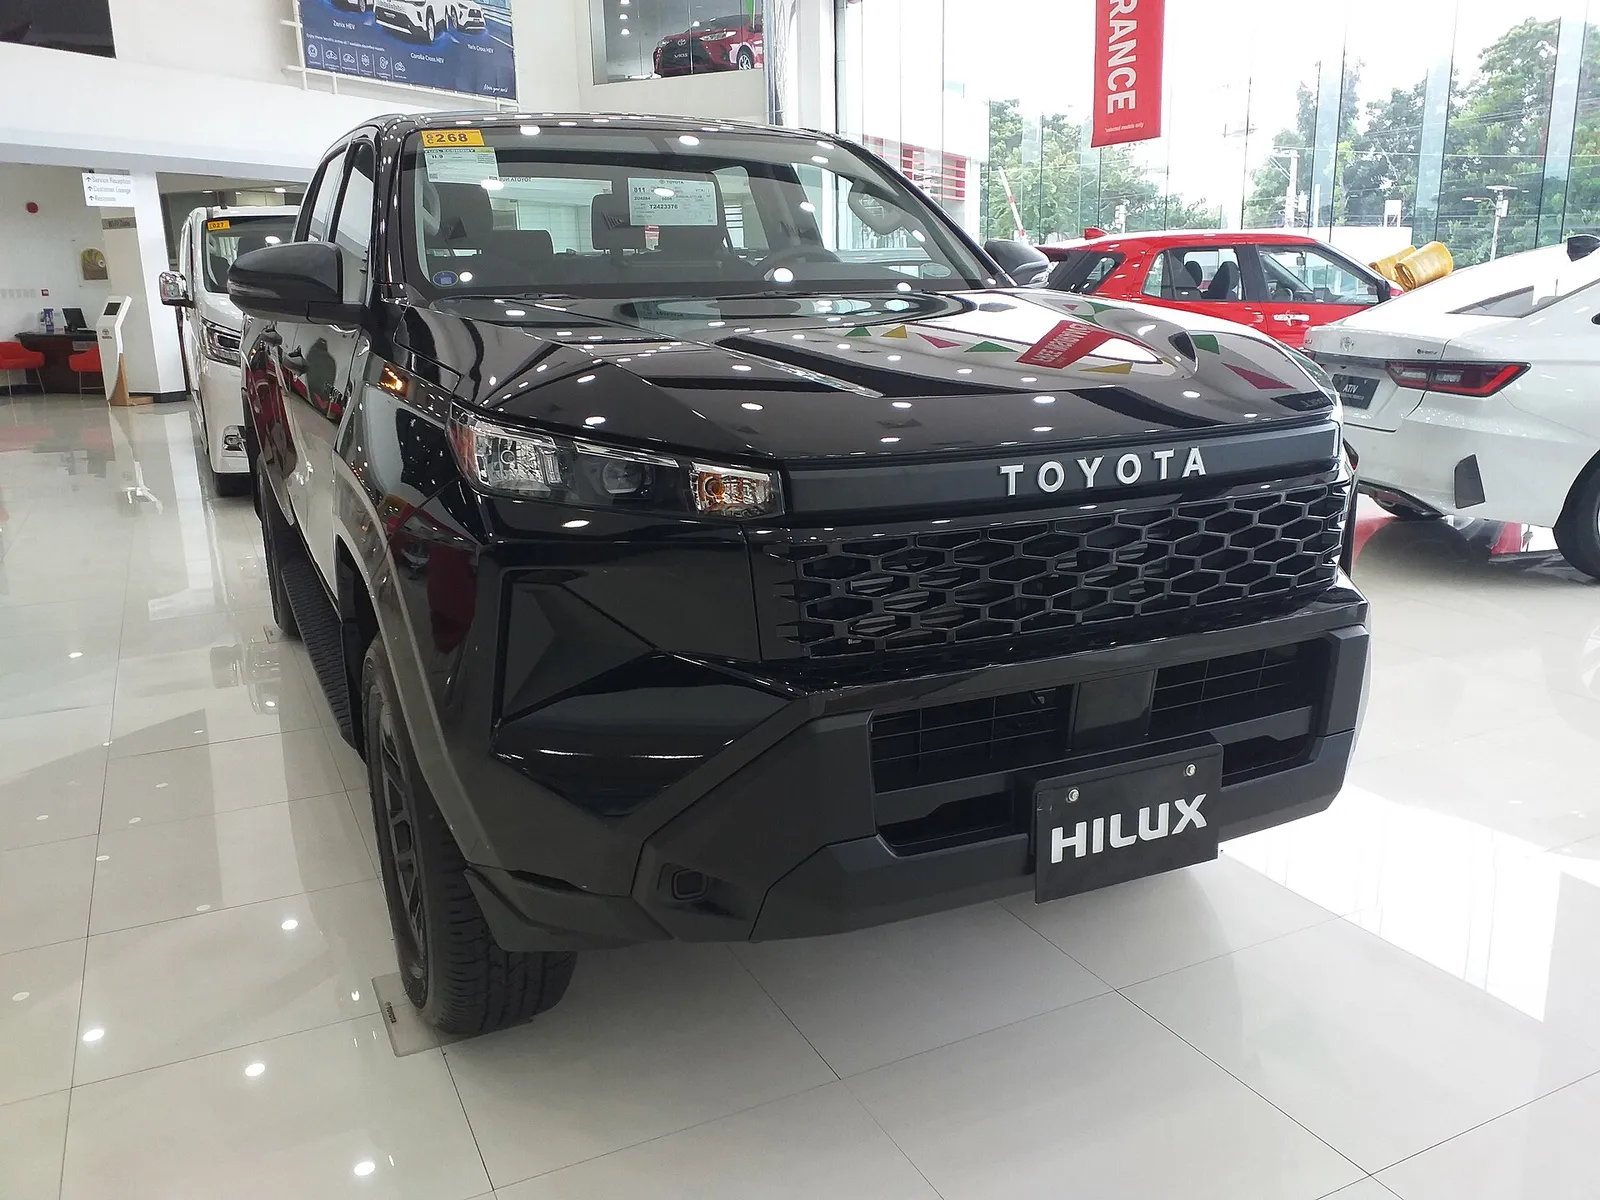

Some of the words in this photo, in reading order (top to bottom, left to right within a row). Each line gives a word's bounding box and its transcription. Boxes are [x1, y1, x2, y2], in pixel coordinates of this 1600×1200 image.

[333, 20, 346, 28] Zenix
[410, 52, 425, 60] Corolla
[435, 133, 468, 142] 268
[92, 176, 108, 184] Service
[1343, 383, 1360, 393] ATIV
[998, 446, 1207, 496] TOYOTA
[1051, 793, 1207, 864] HILUX
